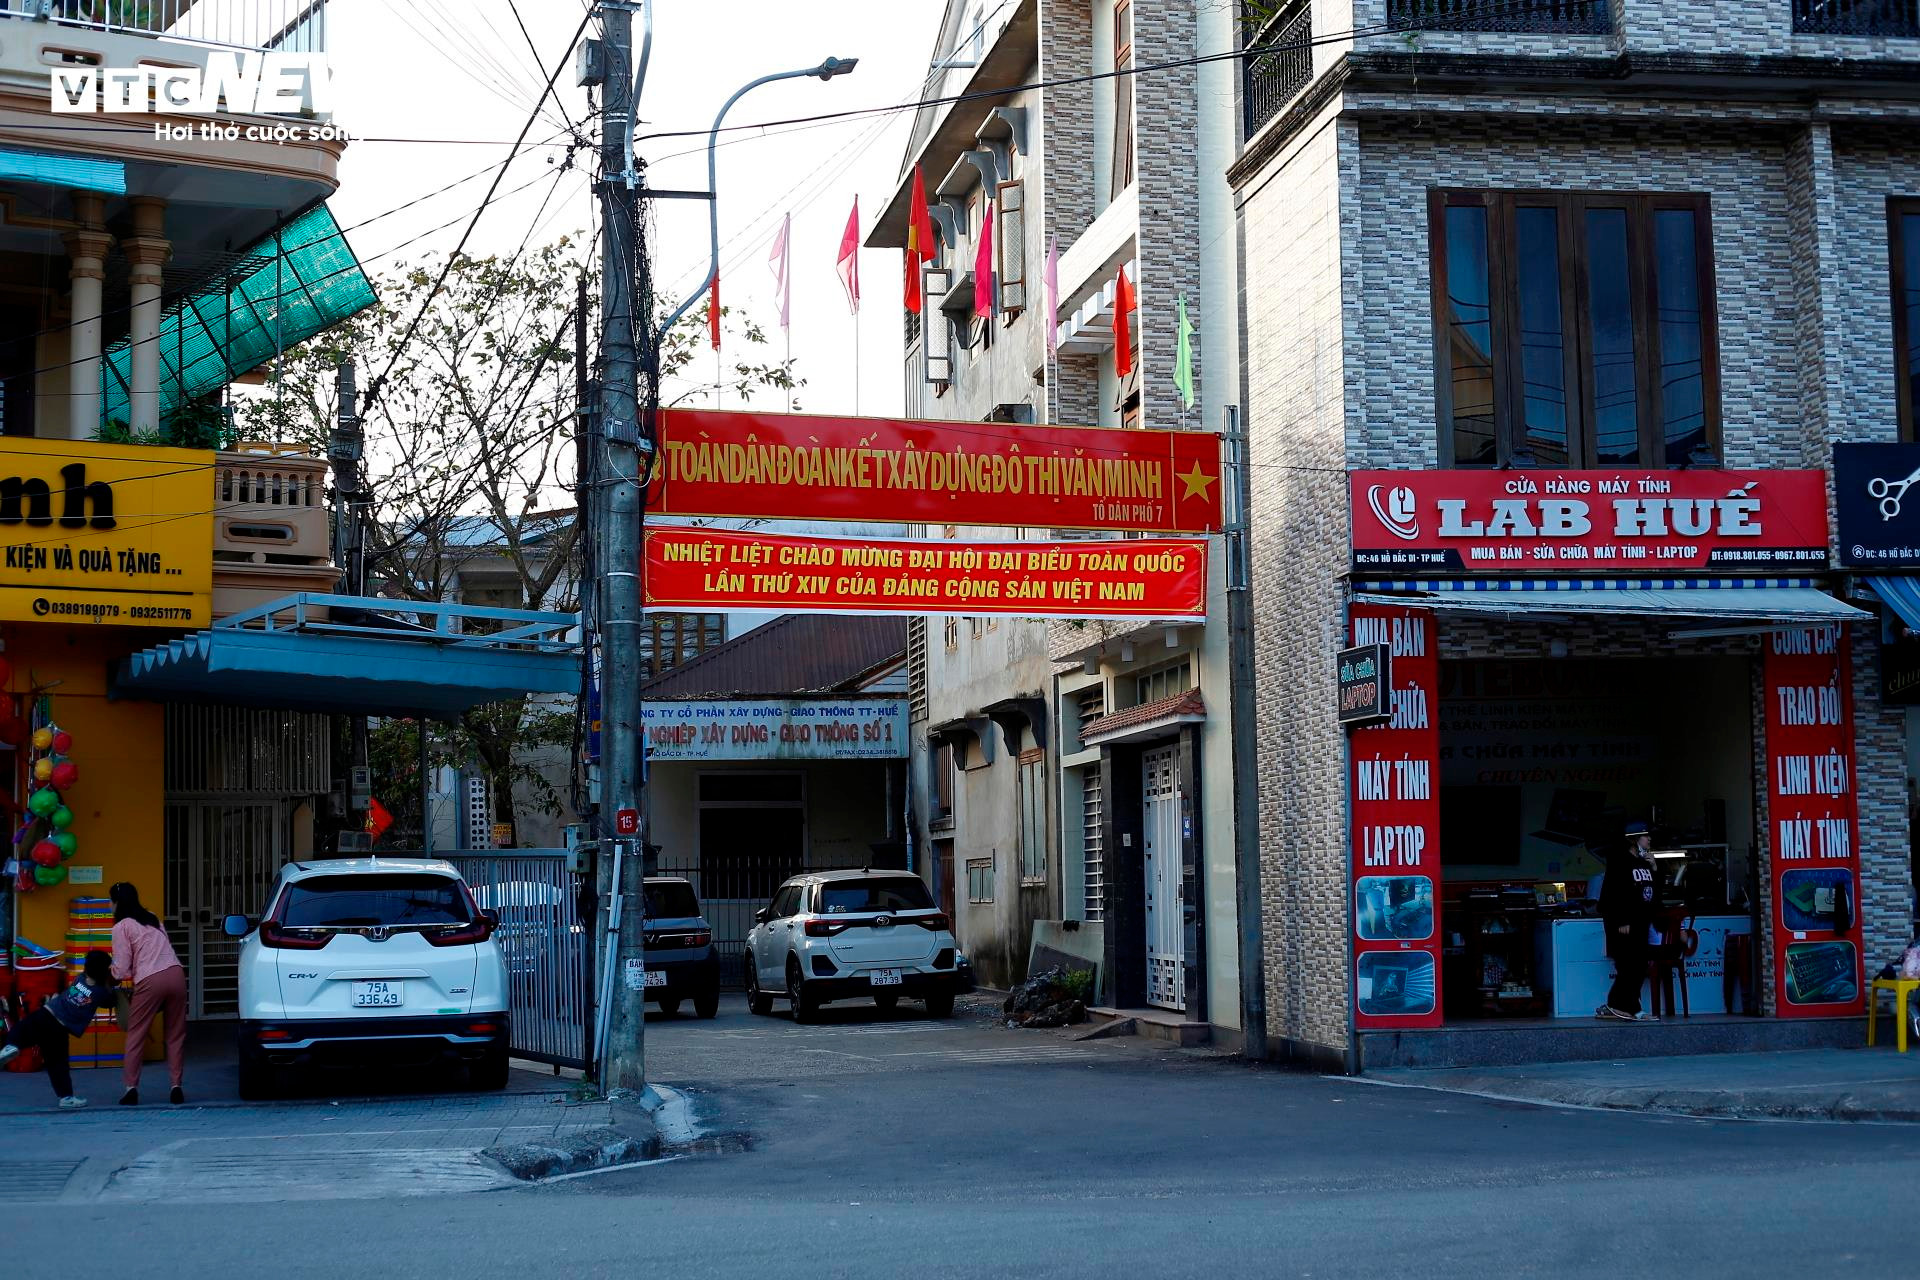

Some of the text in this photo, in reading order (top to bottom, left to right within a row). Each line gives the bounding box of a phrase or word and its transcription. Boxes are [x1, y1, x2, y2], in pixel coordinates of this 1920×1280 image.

[1505, 476, 1671, 494] CỬA HÀNG MÁY TÍNH
[1092, 497, 1163, 522] TỔ DÂN PHỐ 7
[1437, 481, 1762, 537] LAB HUẾ
[6, 544, 47, 572] KIỆN
[53, 544, 73, 570] VÀ
[79, 547, 112, 572] QUÀ
[117, 548, 161, 576] TẶNG
[664, 538, 1185, 574] NHIỆT LIỆT CHÀO MỪNG ĐẠI HỘI ĐẠI BIỂU TOÀN QUỐC
[1471, 547, 1496, 559] MUA
[1500, 544, 1522, 559] BÁN
[1533, 543, 1555, 559] SỬA
[1560, 543, 1589, 559] CHỮA
[1594, 543, 1616, 559] MÁY
[1621, 543, 1646, 559] TÍNH
[1657, 546, 1698, 559] LAPTOP
[704, 567, 1145, 603] LẦN THỨ XIV CỦA ĐẢNG CỘNG SẢN VIỆT NAM
[52, 603, 119, 616] 0389199079
[1393, 610, 1425, 657] BÁN
[660, 709, 674, 718] TY
[729, 706, 749, 717] XÂY
[791, 707, 815, 717] GIAO
[819, 706, 855, 717] THÔNG
[1341, 682, 1376, 711] LAPTOP
[1777, 686, 1816, 726] TRAO
[701, 722, 727, 744] XÂY
[780, 723, 811, 742] GIAO
[815, 720, 859, 742] THÔNG
[863, 717, 882, 742] SỐ
[885, 723, 893, 742] 1
[1358, 753, 1430, 801] MÁY TÍNH
[1777, 747, 1849, 799] LINH KIỆN
[1364, 825, 1425, 866] LAPTOP
[1780, 811, 1850, 859] MÁY TÍNH
[358, 993, 398, 1005] 336.49
[367, 982, 389, 993] 75A
